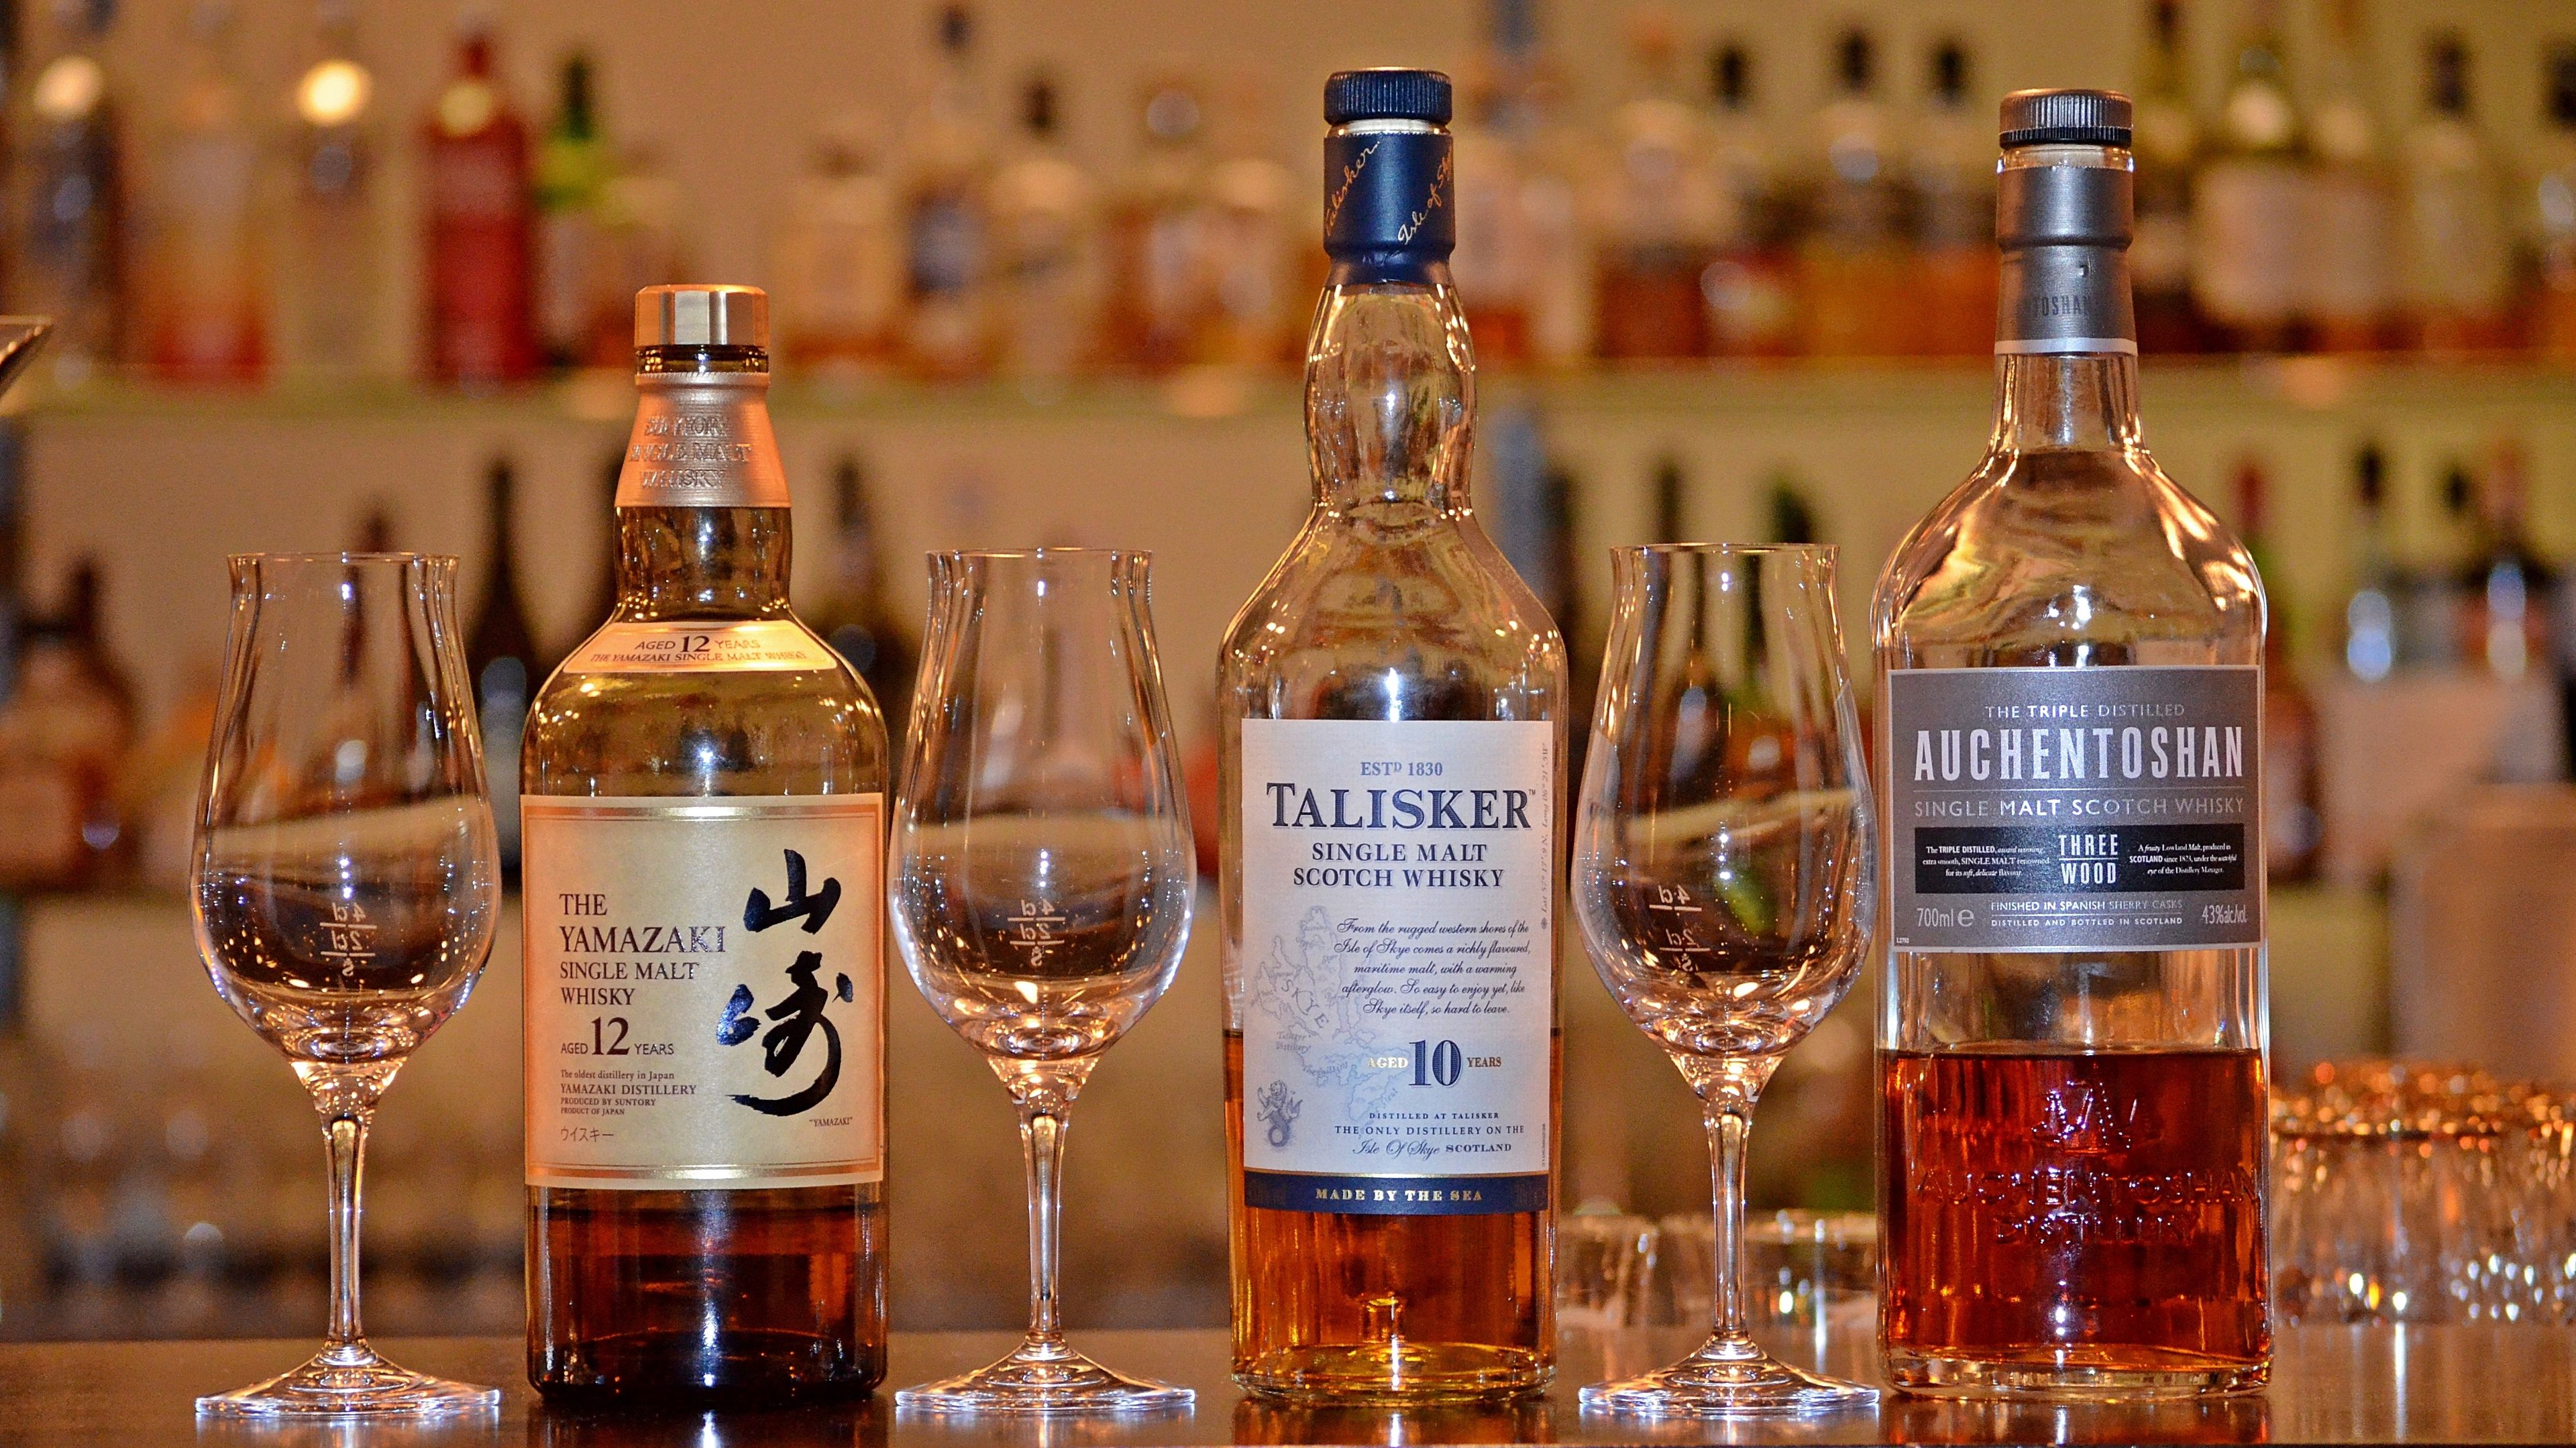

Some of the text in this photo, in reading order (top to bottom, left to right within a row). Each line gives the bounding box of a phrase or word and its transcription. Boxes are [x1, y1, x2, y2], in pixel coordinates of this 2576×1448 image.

[1398, 183, 1442, 245] Isle of
[635, 635, 761, 653] AGED 12 YEARS
[590, 653, 611, 661] THE
[612, 653, 670, 661] YAMAZAKI
[674, 653, 722, 661] SINGLE
[727, 652, 761, 660] MALT
[1985, 704, 2185, 718] THE TRIPLE DISTILLED
[1914, 726, 2243, 781] AUCHENTOSHAN
[1408, 762, 1444, 777] 1830
[1915, 797, 2244, 817] SINGLE MALT SCOTCH WHISKY
[1312, 842, 1487, 862] SINGLE MALT
[1926, 846, 1938, 854] The
[1939, 846, 1960, 854] TRIPLE
[1962, 846, 1997, 854] DISTILLED,
[2059, 834, 2118, 856] THREE
[2203, 843, 2225, 852] produced
[1938, 858, 1960, 866] smooth,
[1961, 857, 1990, 865] SINGLE
[1991, 857, 2016, 865] MALT
[2017, 857, 2050, 865] renowned
[2129, 855, 2163, 863] SCOTLAND
[2194, 854, 2209, 862] under
[1293, 868, 1505, 888] SCOTCH WHISKY
[2061, 862, 2116, 885] WOOD
[559, 893, 607, 915] THE
[1991, 900, 2182, 911] FINISHED IN SPANISH SHERRY CASKS
[1917, 907, 1954, 928] 700ml
[1336, 918, 1375, 934] From
[1379, 920, 1395, 934] the
[1398, 920, 1436, 939] rugged
[1439, 922, 1477, 934] western
[1479, 920, 1506, 934] shores
[1508, 920, 1519, 938] of
[1517, 920, 1529, 933] the
[559, 926, 726, 953] YAMAZAKI
[1334, 938, 1530, 959] Isle of Skye comes a richly flavoured,
[560, 962, 699, 980] SINGLE MALT
[1354, 961, 1517, 979] maritime malt, with a warming
[561, 987, 635, 1005] WHISKY
[1342, 982, 1397, 999] afterglow.
[1400, 979, 1419, 994] So
[1423, 985, 1447, 999] easy
[1449, 983, 1459, 994] to
[1462, 983, 1490, 999] enjoy
[1491, 983, 1509, 999] yet,
[1510, 980, 1525, 993] like
[1362, 998, 1397, 1019] Skye
[1399, 1001, 1428, 1017] itself,
[1431, 1005, 1442, 1014] so
[1444, 1001, 1470, 1014] hard
[1472, 1002, 1481, 1013] to
[1483, 1001, 1509, 1013] leave.
[561, 1016, 674, 1056] AGED 12 YEARS
[1368, 1039, 1502, 1087] AGED 10 YEARS
[561, 1070, 674, 1081] The oldest distillery in Japan
[561, 1084, 697, 1095] YAMAZAKI DISTILLERY
[561, 1097, 656, 1107] PRODUCED BY SUNTORY
[602, 1108, 625, 1116] JAPAN
[560, 1125, 614, 1142] ウイスキー
[1334, 1125, 1525, 1135] THE ONLY DISTILLERY ON THE
[1352, 1139, 1512, 1160] Isle Of Skye SCOTLAND
[1315, 1188, 1483, 1202] MADE BY THE SEA
